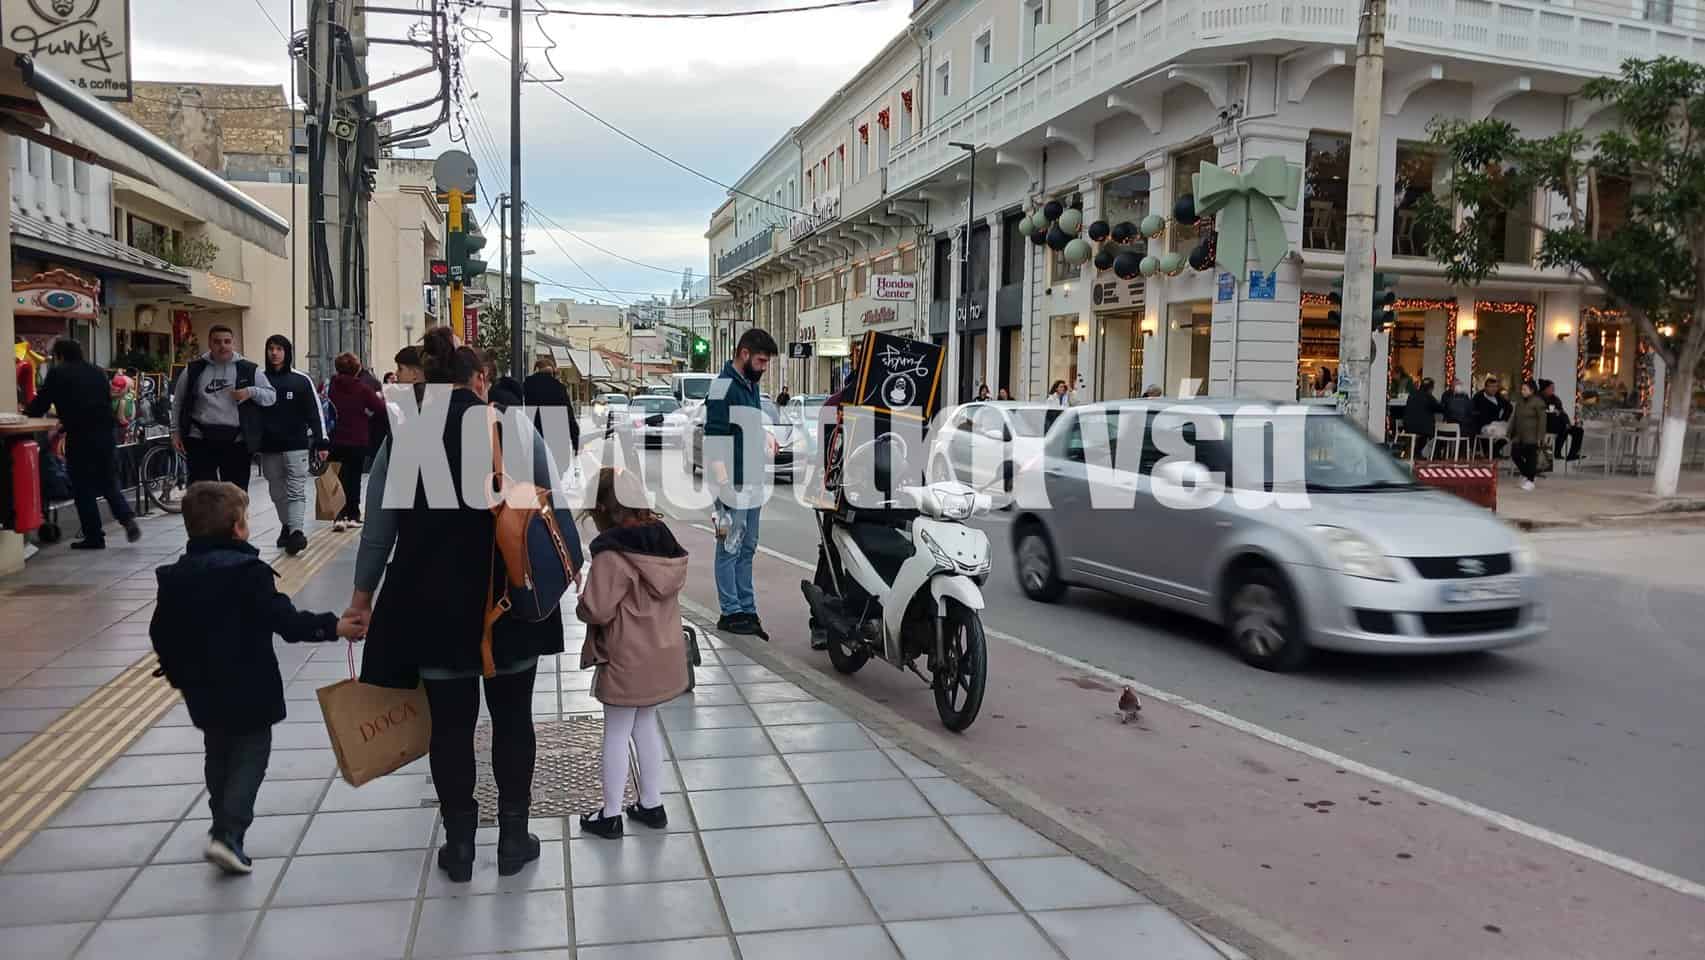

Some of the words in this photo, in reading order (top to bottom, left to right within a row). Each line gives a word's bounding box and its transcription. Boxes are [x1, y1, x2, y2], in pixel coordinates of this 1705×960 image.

[78, 78, 88, 89] &
[89, 78, 127, 90] coffee
[877, 277, 914, 289] Hondos
[877, 288, 911, 299] Center
[359, 702, 417, 743] DOCA
